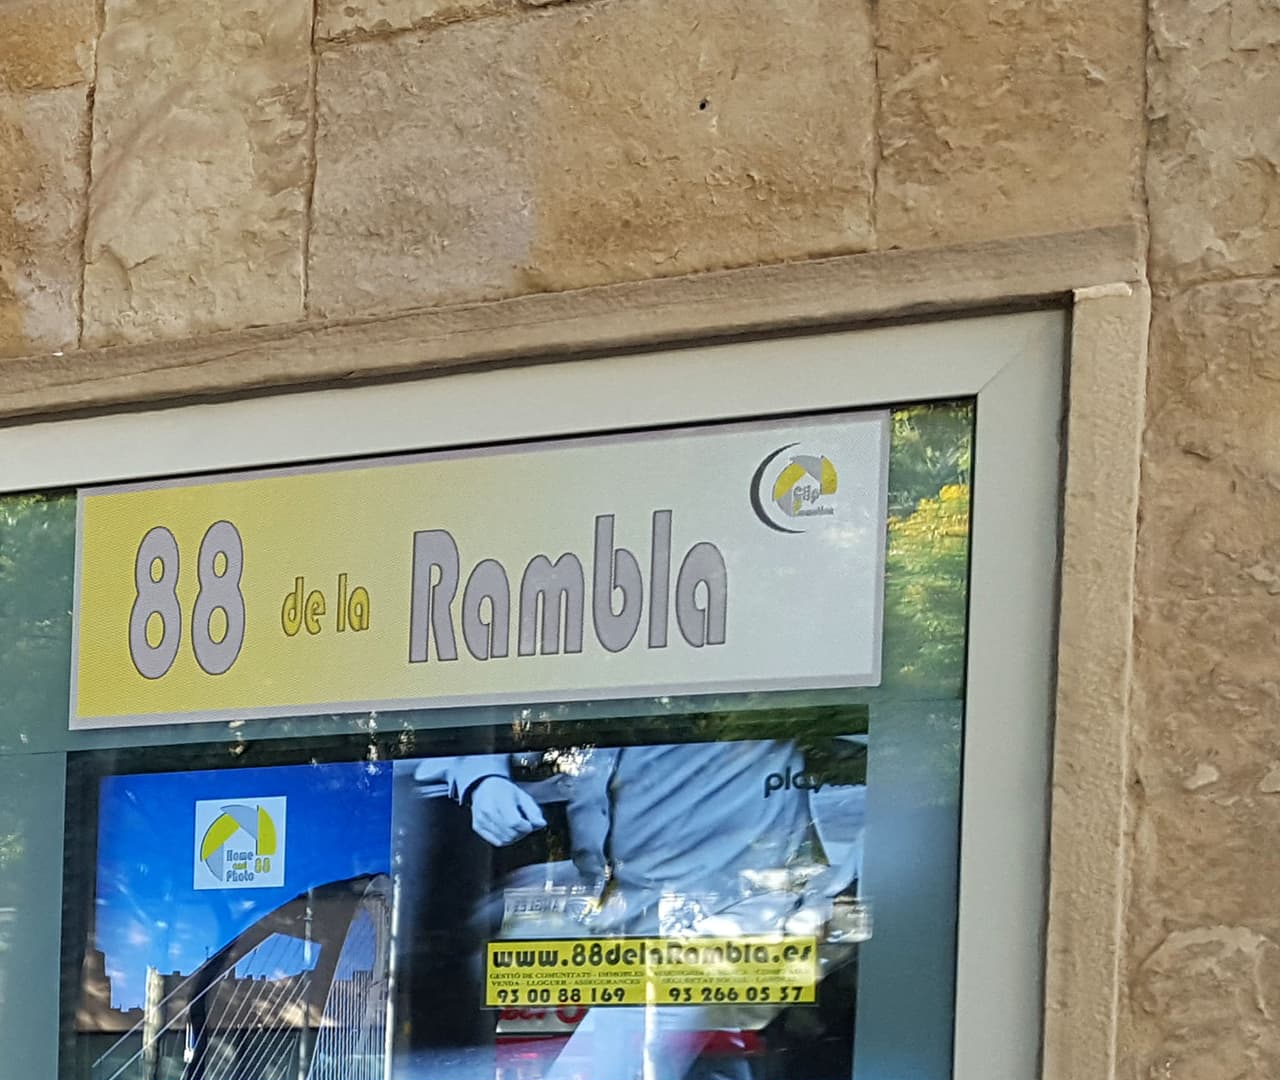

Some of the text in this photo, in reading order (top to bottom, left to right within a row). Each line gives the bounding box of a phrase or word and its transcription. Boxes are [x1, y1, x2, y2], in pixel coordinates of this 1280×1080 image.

[127, 508, 727, 680] 88 de la Rambla
[226, 870, 254, 882] Photo
[497, 987, 804, 1003] 93 00 88 169 93 266 05 37
